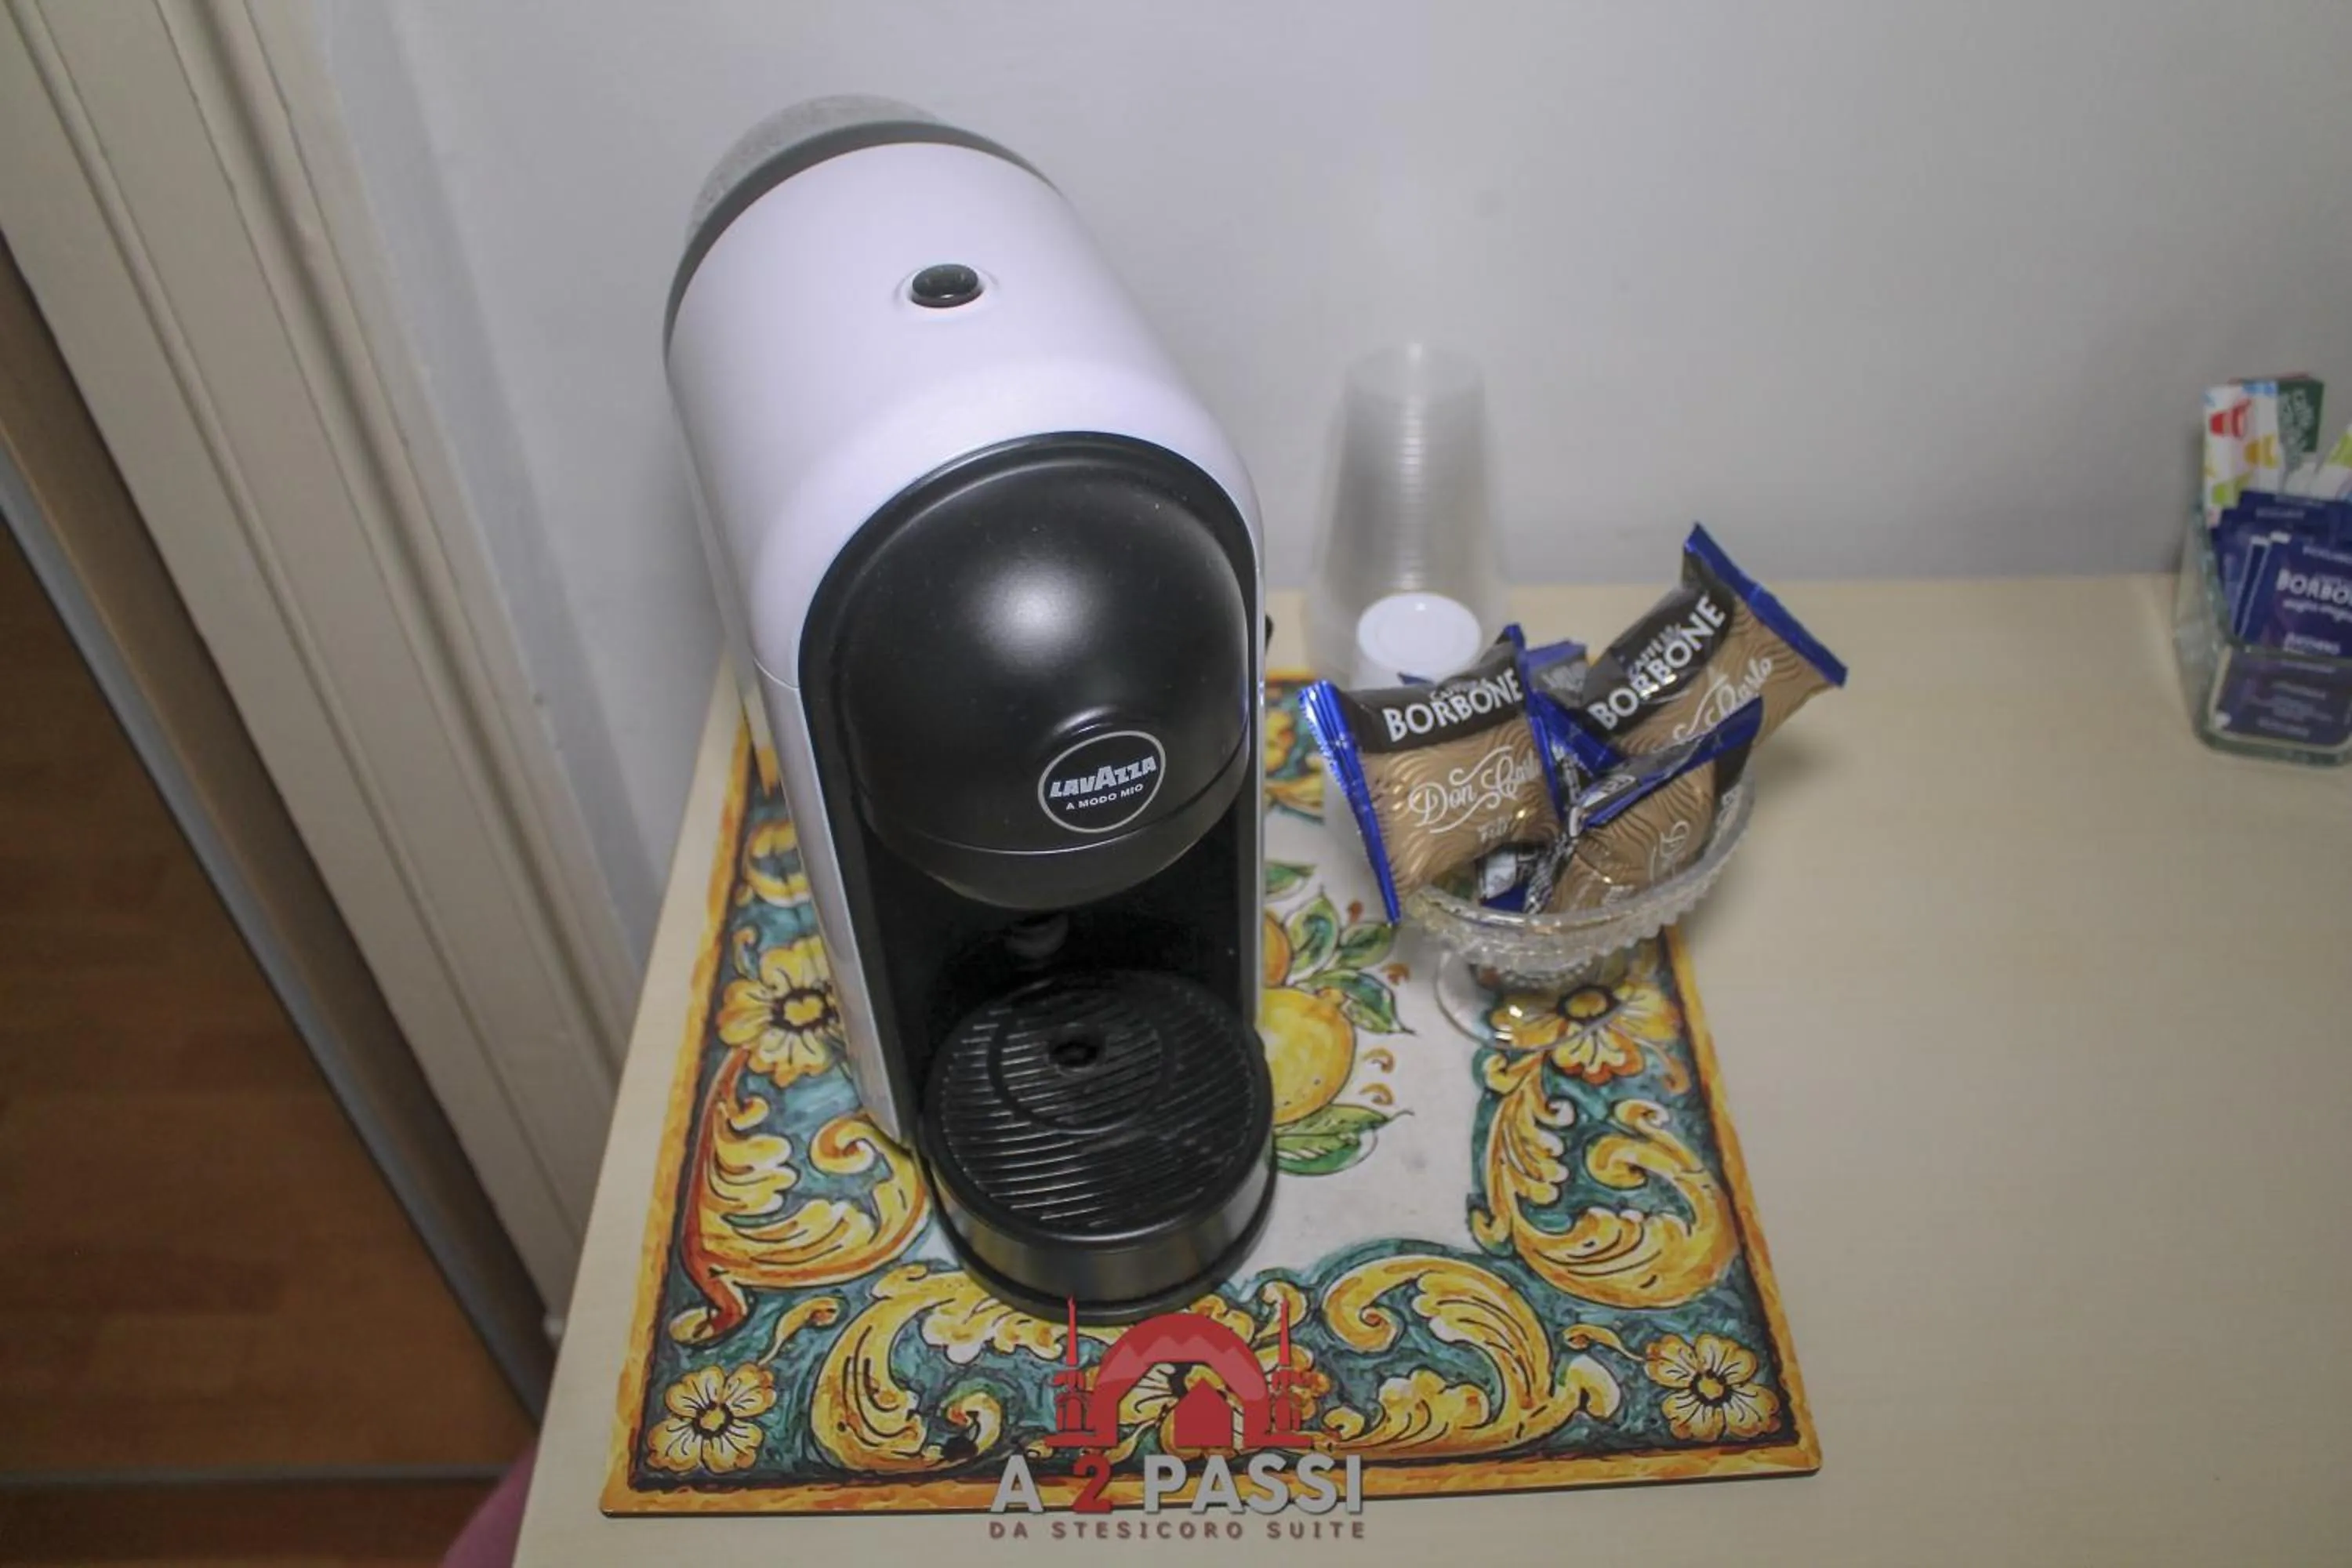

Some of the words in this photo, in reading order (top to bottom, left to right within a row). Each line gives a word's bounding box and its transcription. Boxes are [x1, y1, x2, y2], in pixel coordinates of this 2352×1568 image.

[1588, 592, 1726, 730] BORBONE
[1382, 668, 1523, 742] BORBONE
[1050, 756, 1157, 798] LAVAZZA
[1065, 802, 1075, 811] A
[1078, 793, 1117, 808] MODO
[1120, 783, 1144, 798] MIO
[1408, 782, 1478, 828] Don
